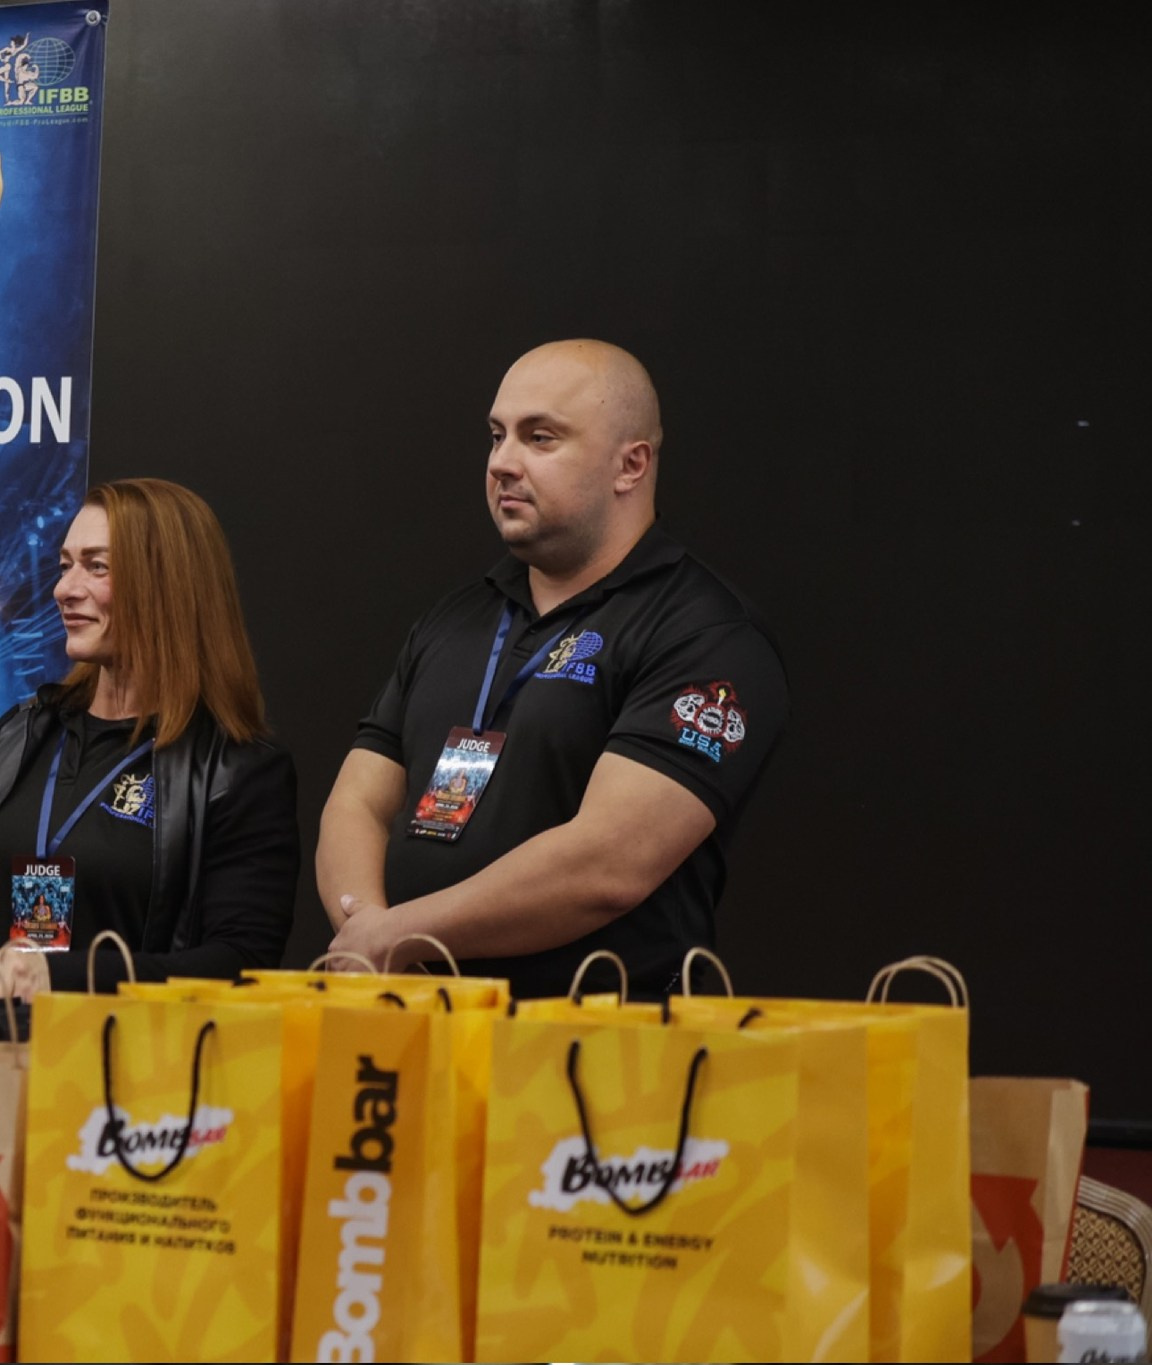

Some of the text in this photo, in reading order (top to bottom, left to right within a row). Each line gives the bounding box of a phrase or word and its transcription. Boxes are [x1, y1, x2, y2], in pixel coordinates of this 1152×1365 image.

[38, 87, 89, 105] IFBB
[56, 103, 89, 113] LEAGUE
[457, 739, 491, 753] JUDGE
[24, 864, 60, 877] JUDGE
[90, 1188, 219, 1213] ПРОИЗВОДИТЕЛЬ
[66, 1226, 237, 1257] ПИТАНИЯ И НАПИТКОВ
[549, 1226, 715, 1252] PROTEIN & ENERGY
[581, 1252, 679, 1271] NUTRITION
